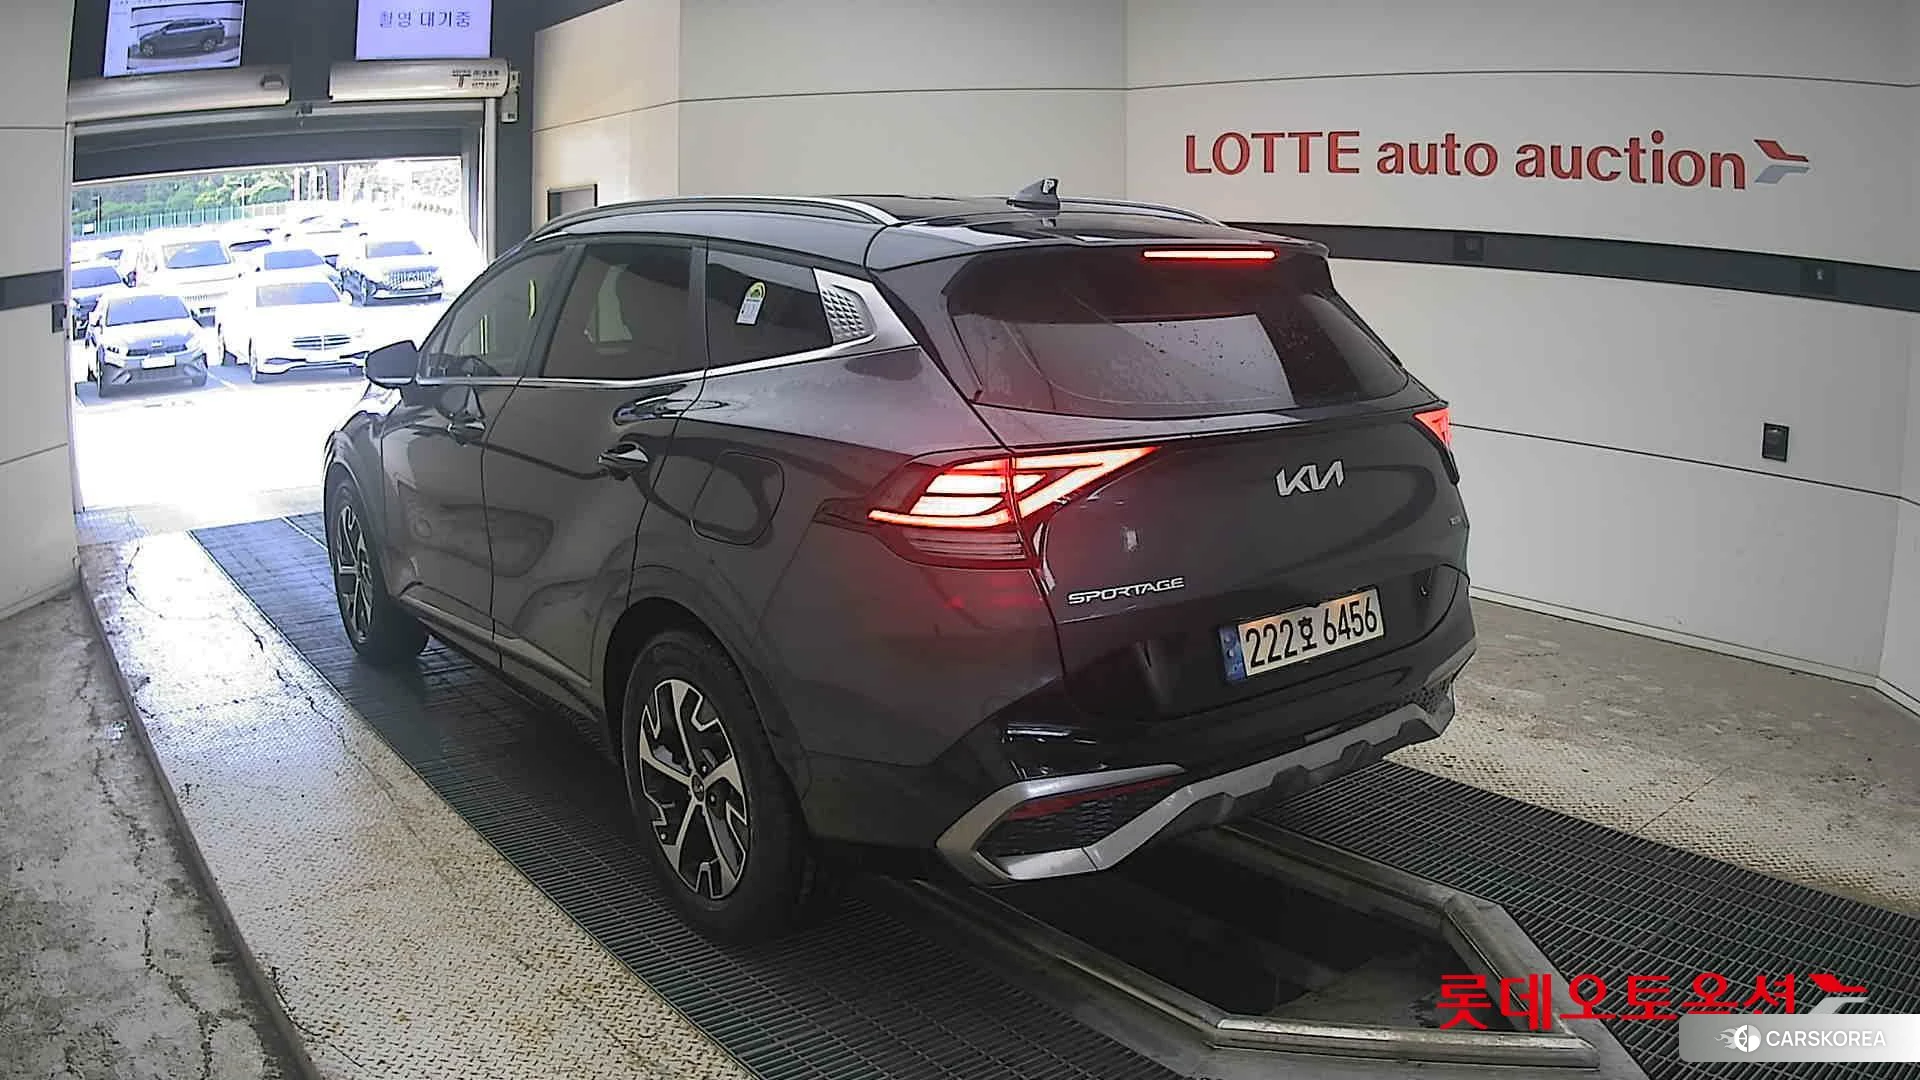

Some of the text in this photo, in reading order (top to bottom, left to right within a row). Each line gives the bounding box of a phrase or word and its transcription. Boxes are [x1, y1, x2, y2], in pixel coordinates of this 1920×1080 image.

[420, 11, 471, 28] 대기중
[1185, 130, 1746, 190] LOTTE auto auction
[1274, 459, 1345, 497] KIA
[1067, 576, 1185, 606] SPORTAGE
[1245, 596, 1378, 668] 222호 6456
